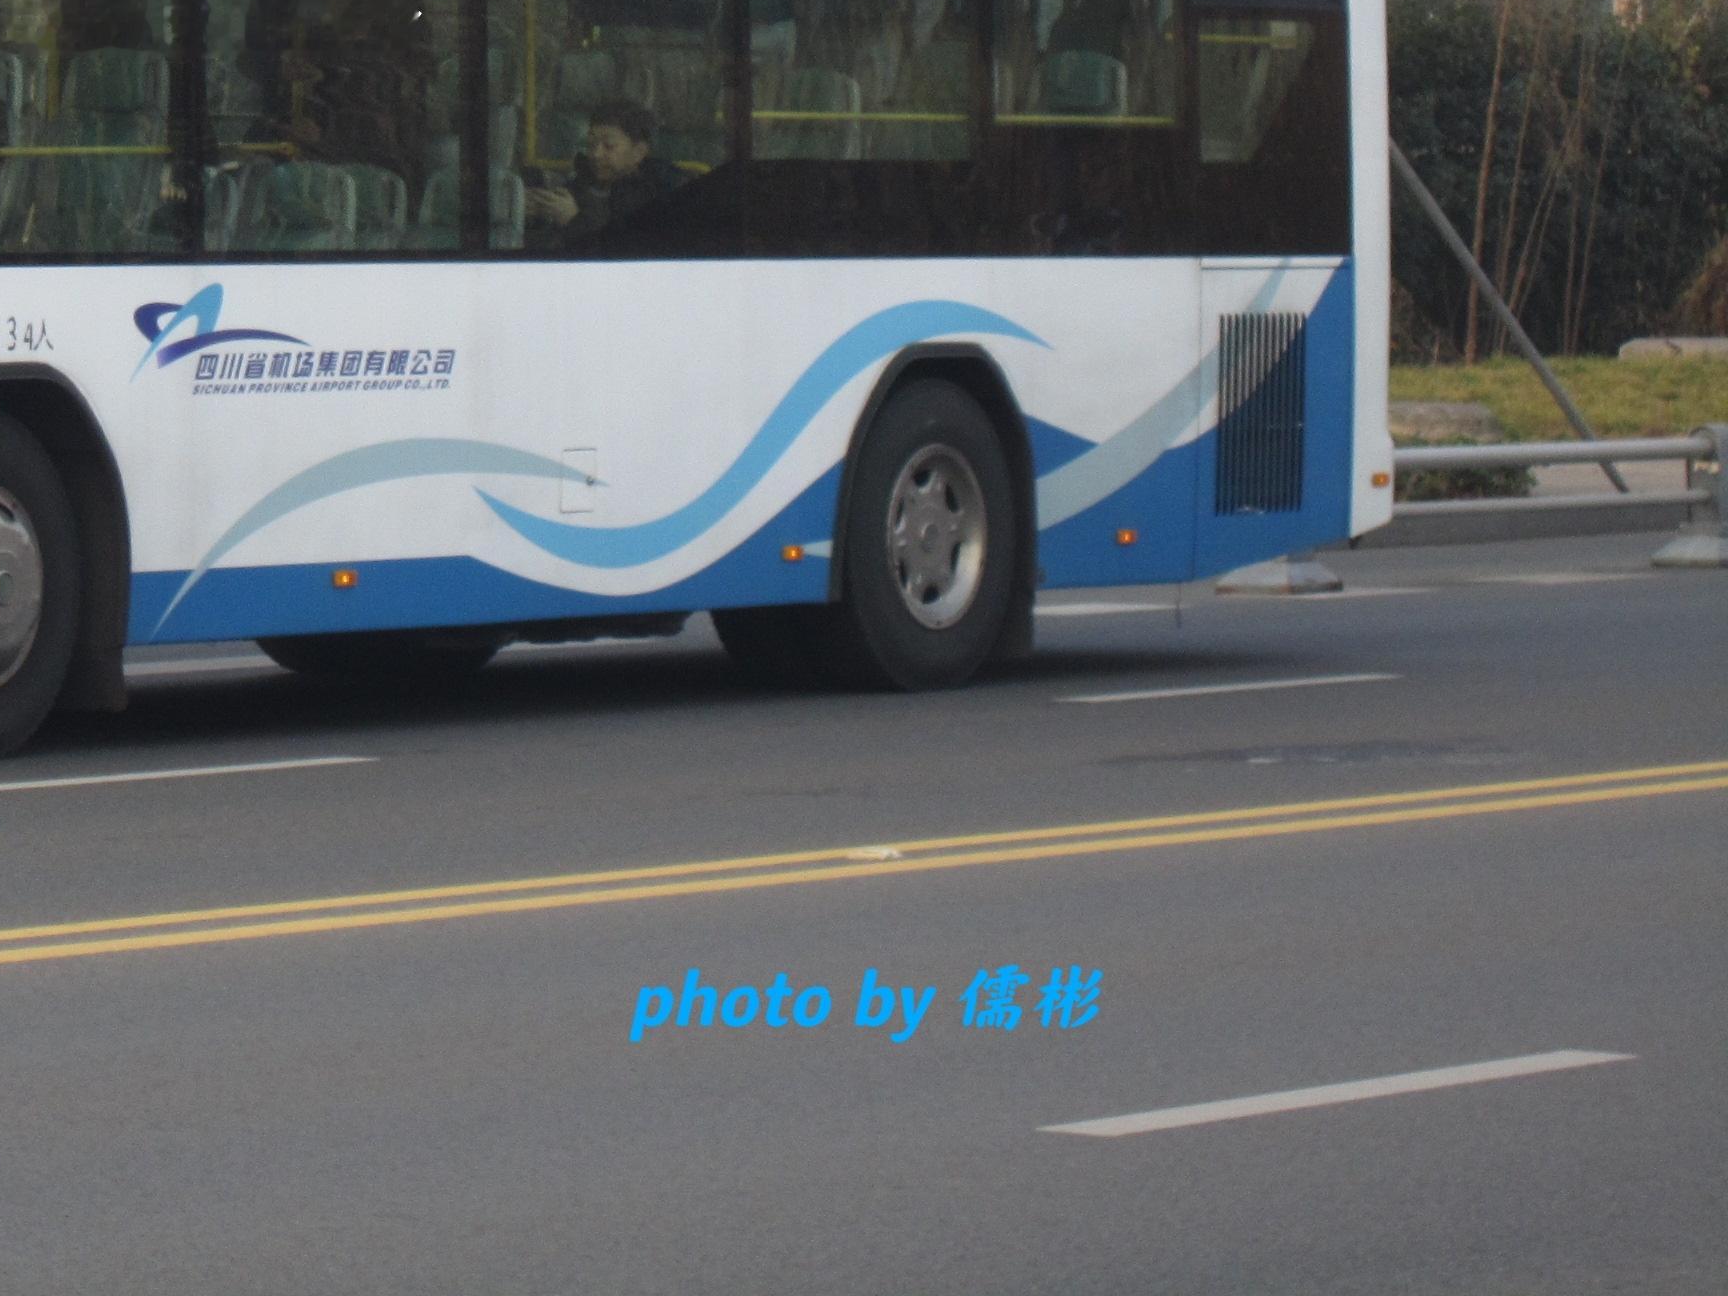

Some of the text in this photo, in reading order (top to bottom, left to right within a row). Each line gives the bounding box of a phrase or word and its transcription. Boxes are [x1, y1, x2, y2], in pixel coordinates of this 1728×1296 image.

[195, 350, 455, 380] 四川省机场集团有限公司
[193, 384, 246, 395] SICHUAN
[248, 382, 307, 394] PROVINCE
[310, 380, 361, 392] AIRPORT
[363, 380, 403, 391] GROUP
